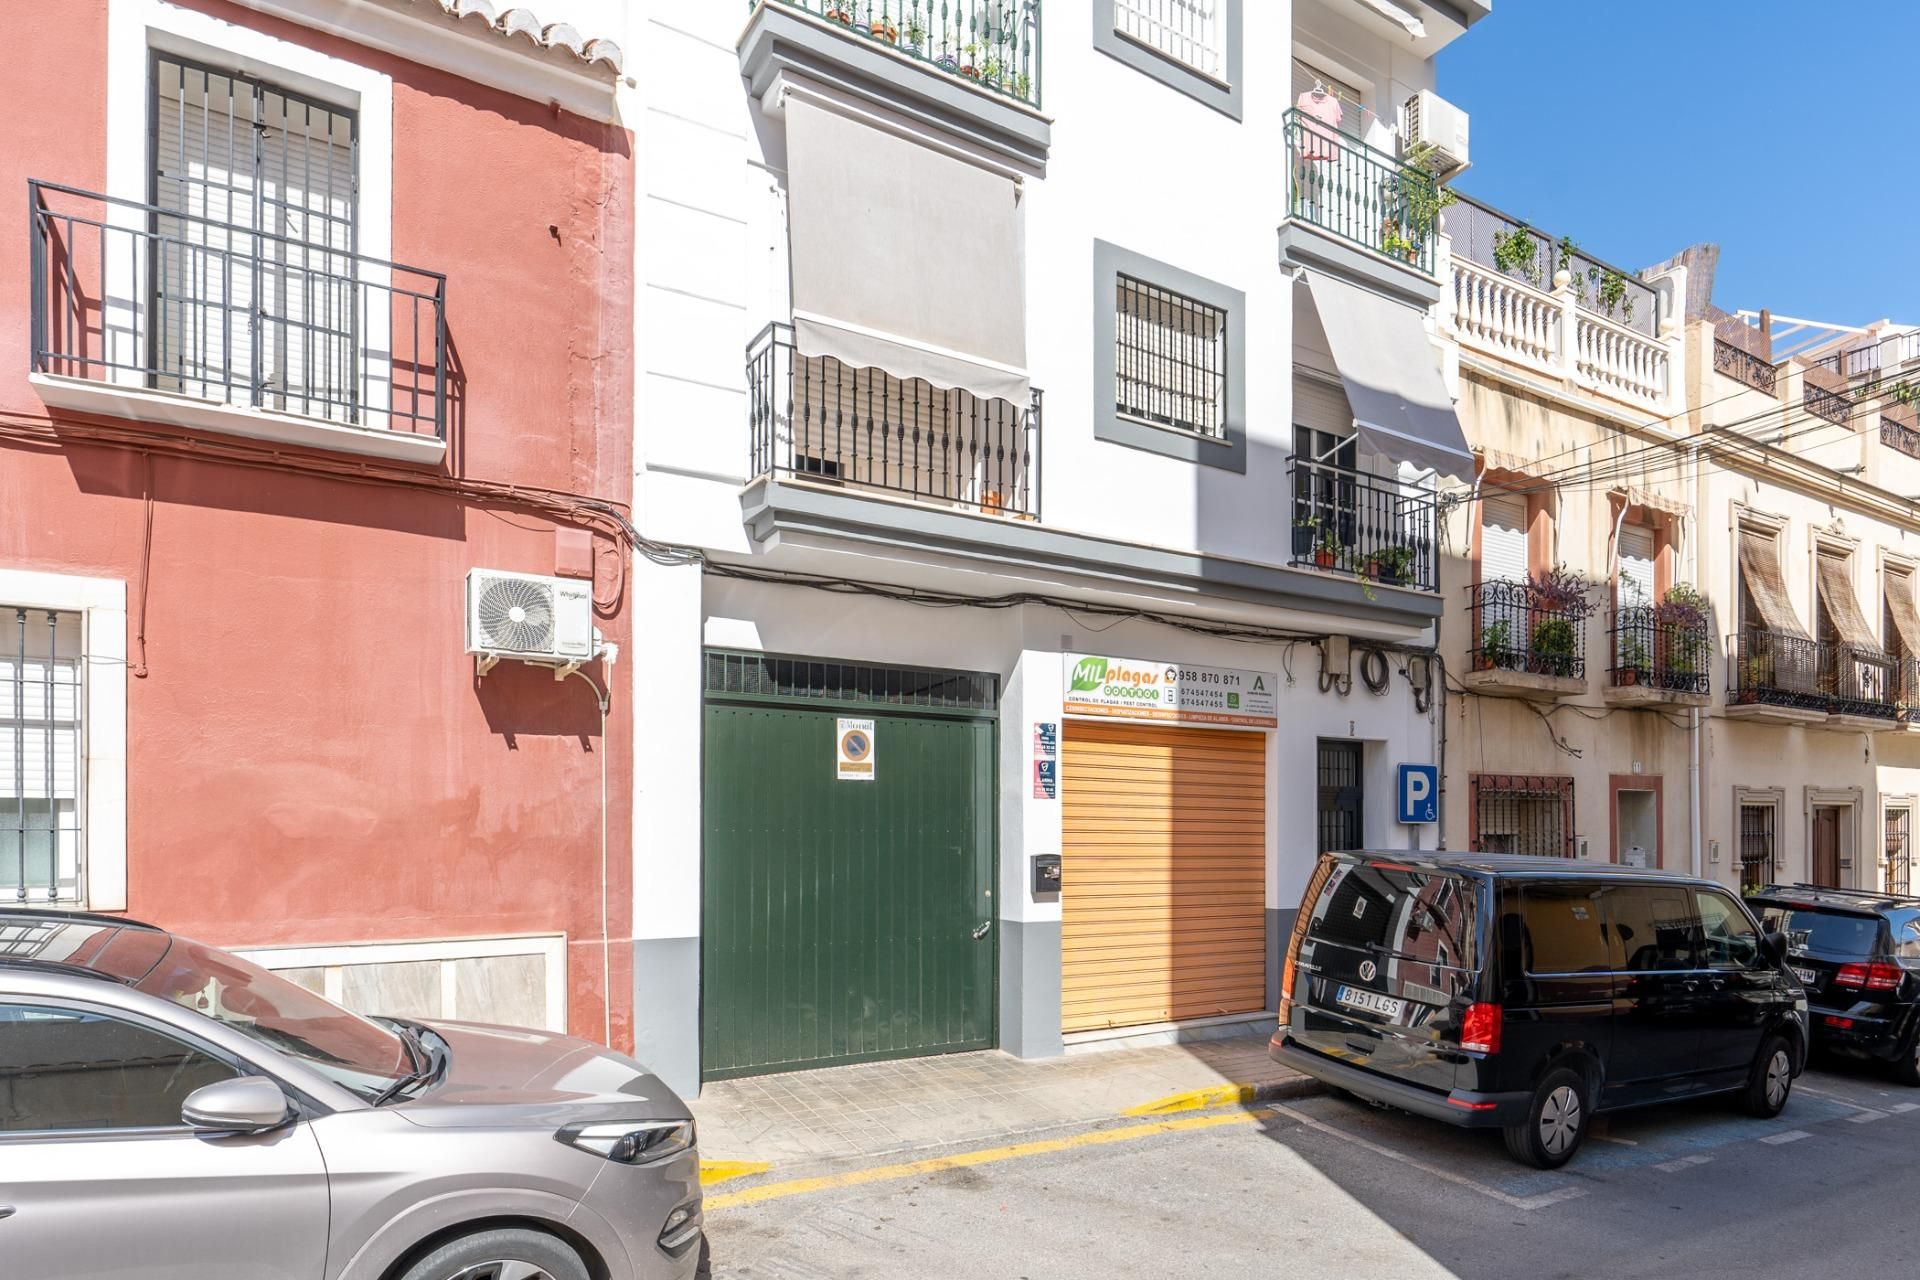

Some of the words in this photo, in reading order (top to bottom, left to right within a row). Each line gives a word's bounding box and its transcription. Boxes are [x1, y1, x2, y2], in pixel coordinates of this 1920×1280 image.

[1073, 663, 1103, 683] MIL
[1105, 666, 1159, 687] plagas
[1179, 670, 1197, 681] 958
[1201, 672, 1219, 684] 870
[1223, 674, 1240, 685] 871
[1406, 771, 1430, 816] P
[1345, 989, 1372, 1006] 8151
[1374, 996, 1399, 1013] LGS
